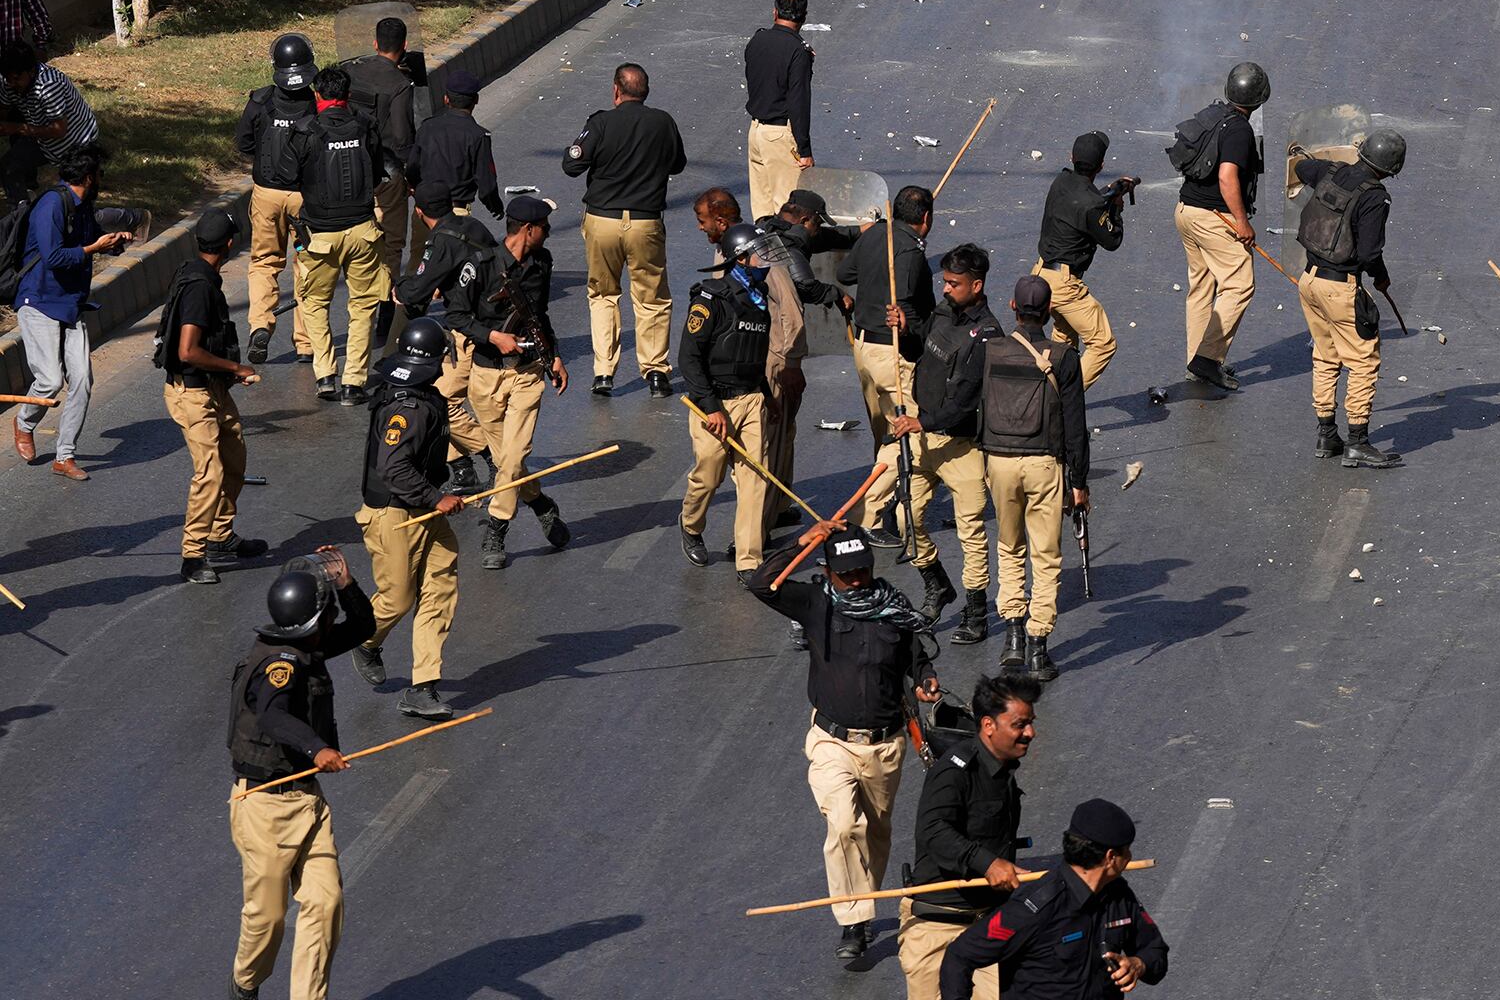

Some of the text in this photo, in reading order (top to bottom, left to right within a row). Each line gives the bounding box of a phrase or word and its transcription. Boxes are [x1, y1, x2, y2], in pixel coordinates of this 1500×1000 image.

[328, 139, 360, 151] POLICE
[738, 321, 767, 333] POLICE
[834, 539, 865, 555] POLICE
